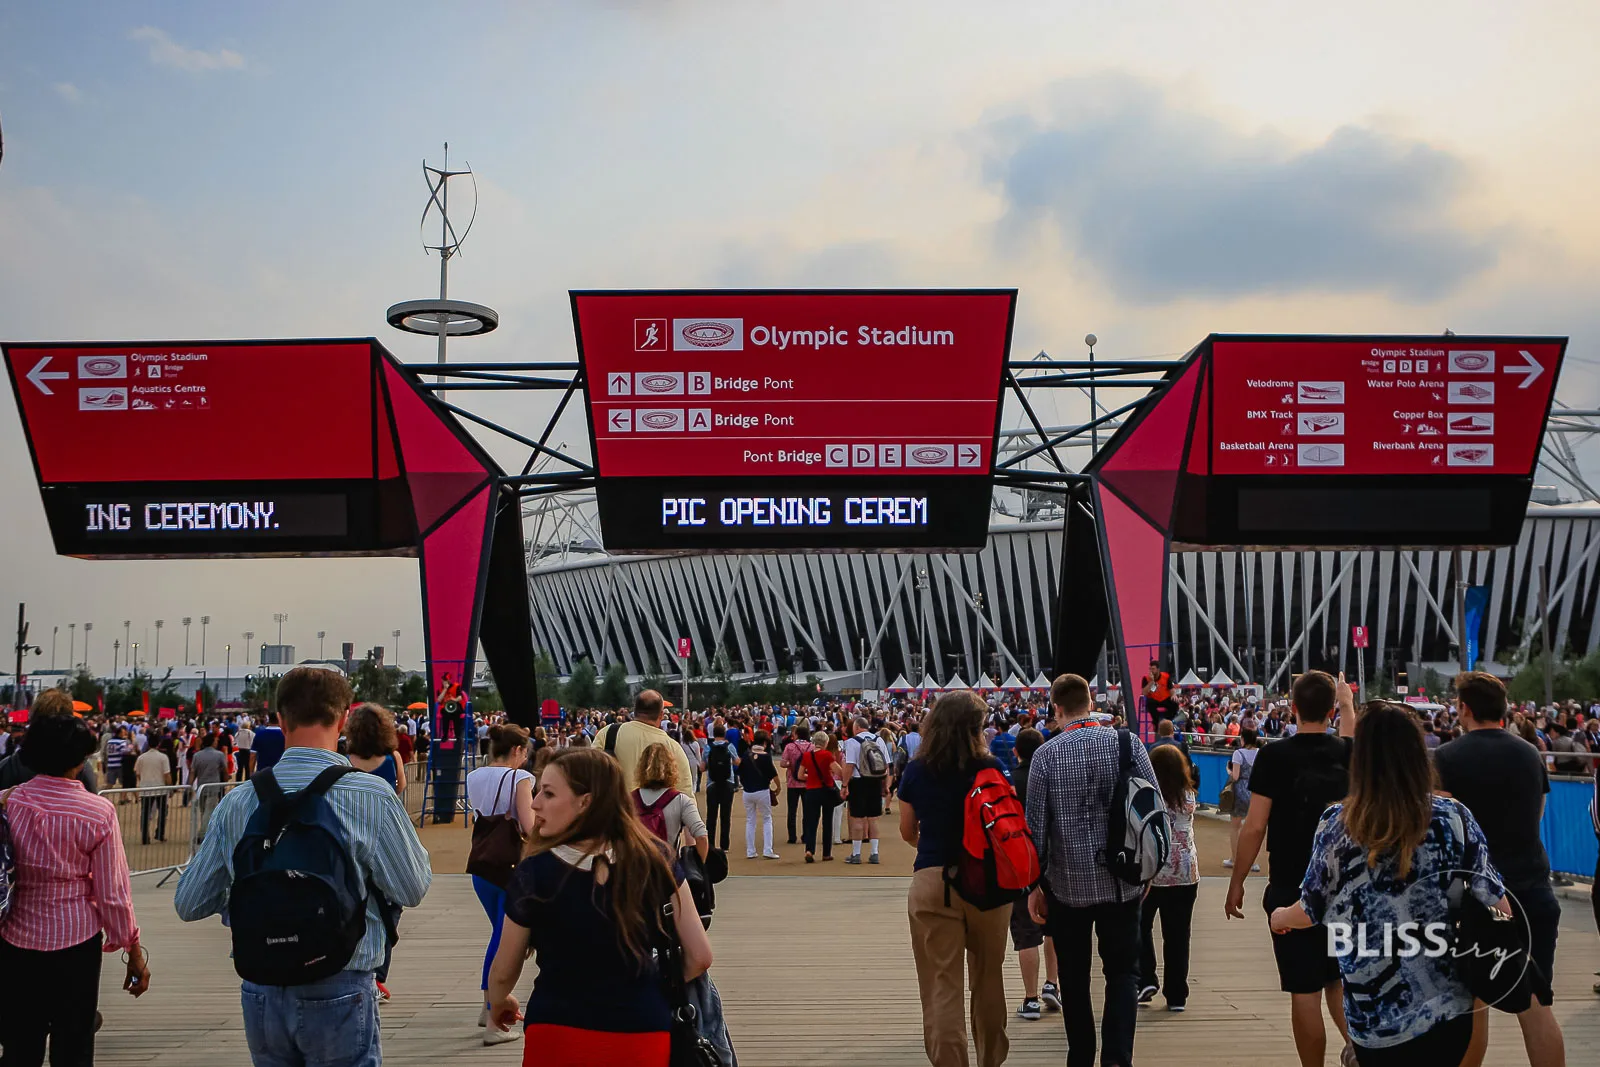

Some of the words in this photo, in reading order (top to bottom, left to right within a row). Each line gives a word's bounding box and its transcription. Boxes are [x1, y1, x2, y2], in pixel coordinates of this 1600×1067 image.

[750, 325, 848, 351] Olympic
[857, 325, 954, 346] Stadium
[130, 352, 168, 363] Olympic
[170, 352, 208, 361] Stadium
[1370, 348, 1407, 358] Olympic
[1409, 348, 1445, 357] Stadium
[150, 367, 160, 377] A
[693, 376, 705, 391] B
[714, 376, 759, 393] Bridge
[764, 376, 794, 390] Pont
[1247, 379, 1295, 388] Velodrome
[1367, 379, 1394, 388] Water
[1396, 379, 1417, 388] Polo
[1418, 379, 1445, 388] Arena
[131, 385, 172, 395] Aquatics
[174, 384, 207, 393] Centre
[1247, 410, 1268, 419] BMX
[1269, 410, 1294, 419] Track
[1392, 410, 1425, 421] Copper
[1427, 410, 1444, 419] Box
[692, 412, 708, 428] A
[714, 413, 759, 430] Bridge
[764, 413, 794, 426] Pont
[1220, 441, 1267, 450] Basketball
[1268, 441, 1294, 450] Arena
[1373, 441, 1415, 450] Riverbank
[1418, 441, 1444, 450] Arena
[743, 450, 774, 464] Pont
[777, 449, 822, 466] Bridge
[829, 448, 844, 464] C
[857, 448, 871, 464] D
[885, 448, 896, 464] E
[85, 503, 131, 531] ING
[144, 501, 280, 530] CEREMONY.
[662, 497, 706, 526] PIC
[719, 497, 831, 525] OPENING
[844, 496, 928, 525] CEREM
